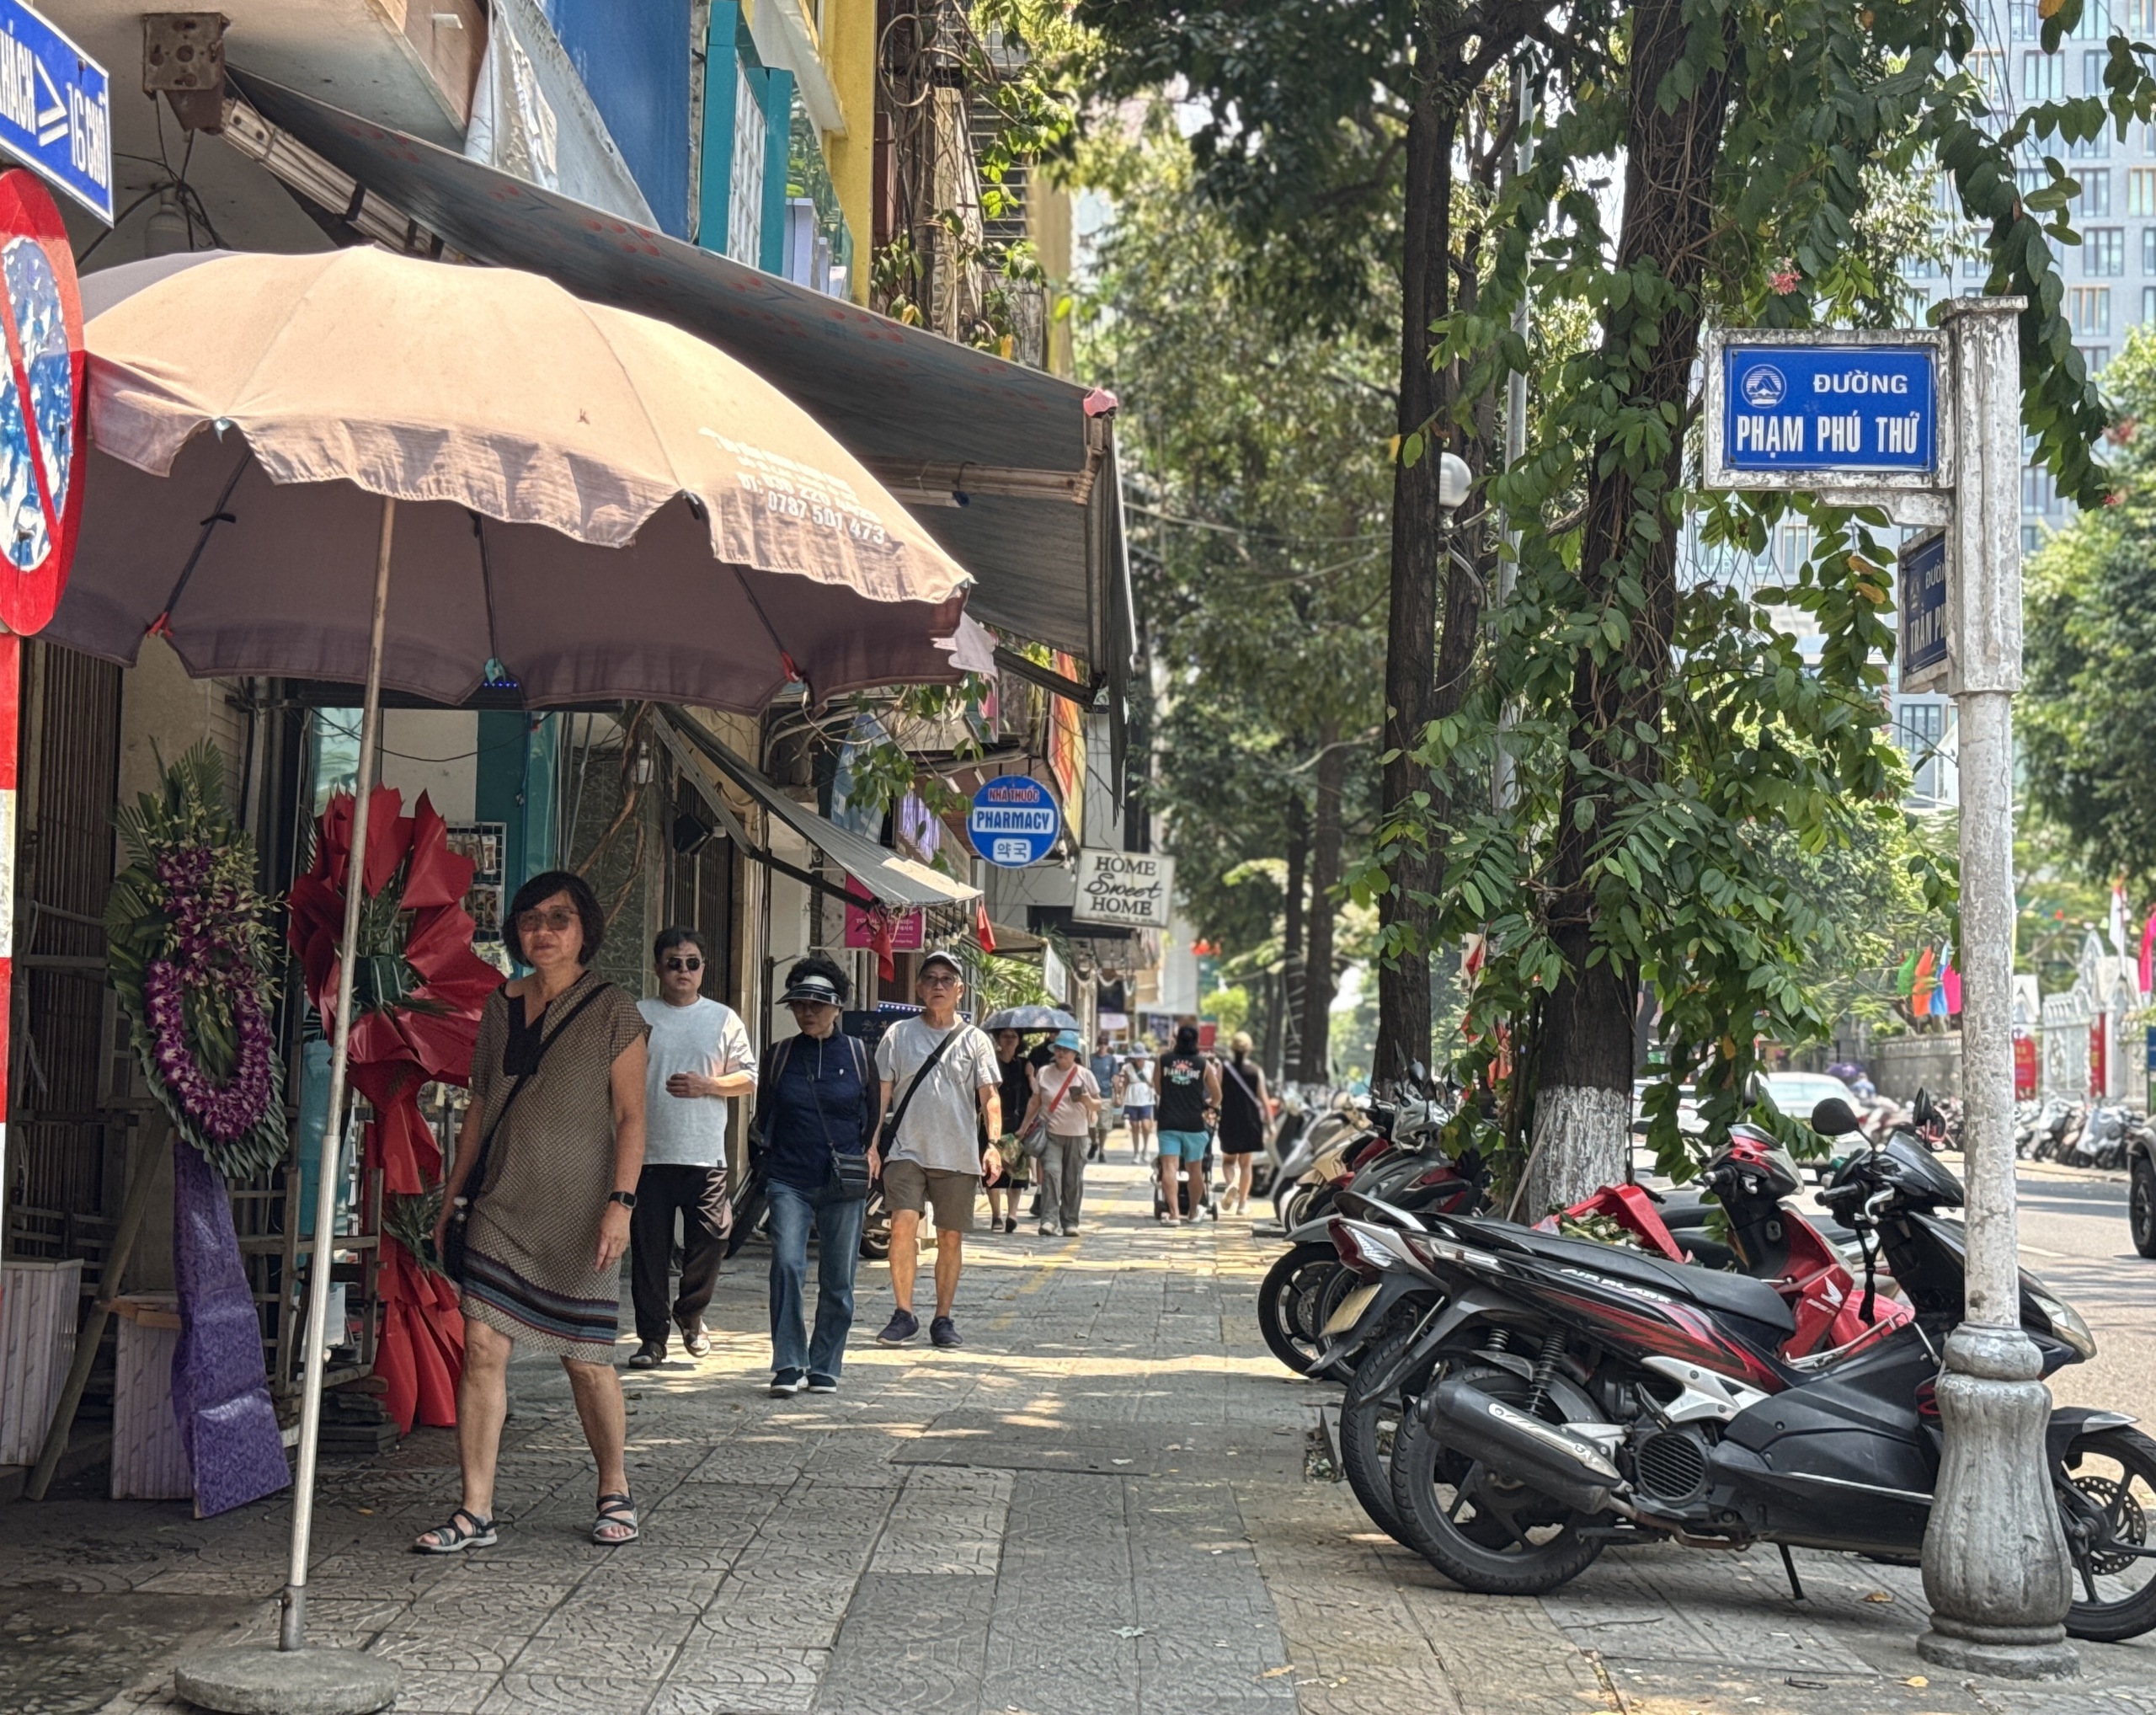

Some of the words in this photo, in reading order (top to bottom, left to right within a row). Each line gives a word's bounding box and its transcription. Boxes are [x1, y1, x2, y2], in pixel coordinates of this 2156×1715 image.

[0, 19, 36, 135] HÁCH
[66, 82, 86, 172] 16
[1813, 370, 1908, 393] ĐƯỜNG
[1737, 414, 1804, 458] PHẠM
[1817, 410, 1860, 453] PHÚ
[1876, 411, 1920, 454] THỨ
[767, 491, 807, 519] 0787
[812, 505, 842, 530] 501
[850, 519, 885, 544] 473
[1925, 558, 1945, 590] ĐƯỜN
[1935, 602, 1946, 642] PH
[1010, 784, 1039, 803] THUỐC
[977, 810, 1050, 830] PHARMACY
[997, 842, 1027, 858] 약국
[1095, 856, 1156, 876] HOME
[1083, 873, 1163, 899] Sweet
[1090, 896, 1153, 916] HOME
